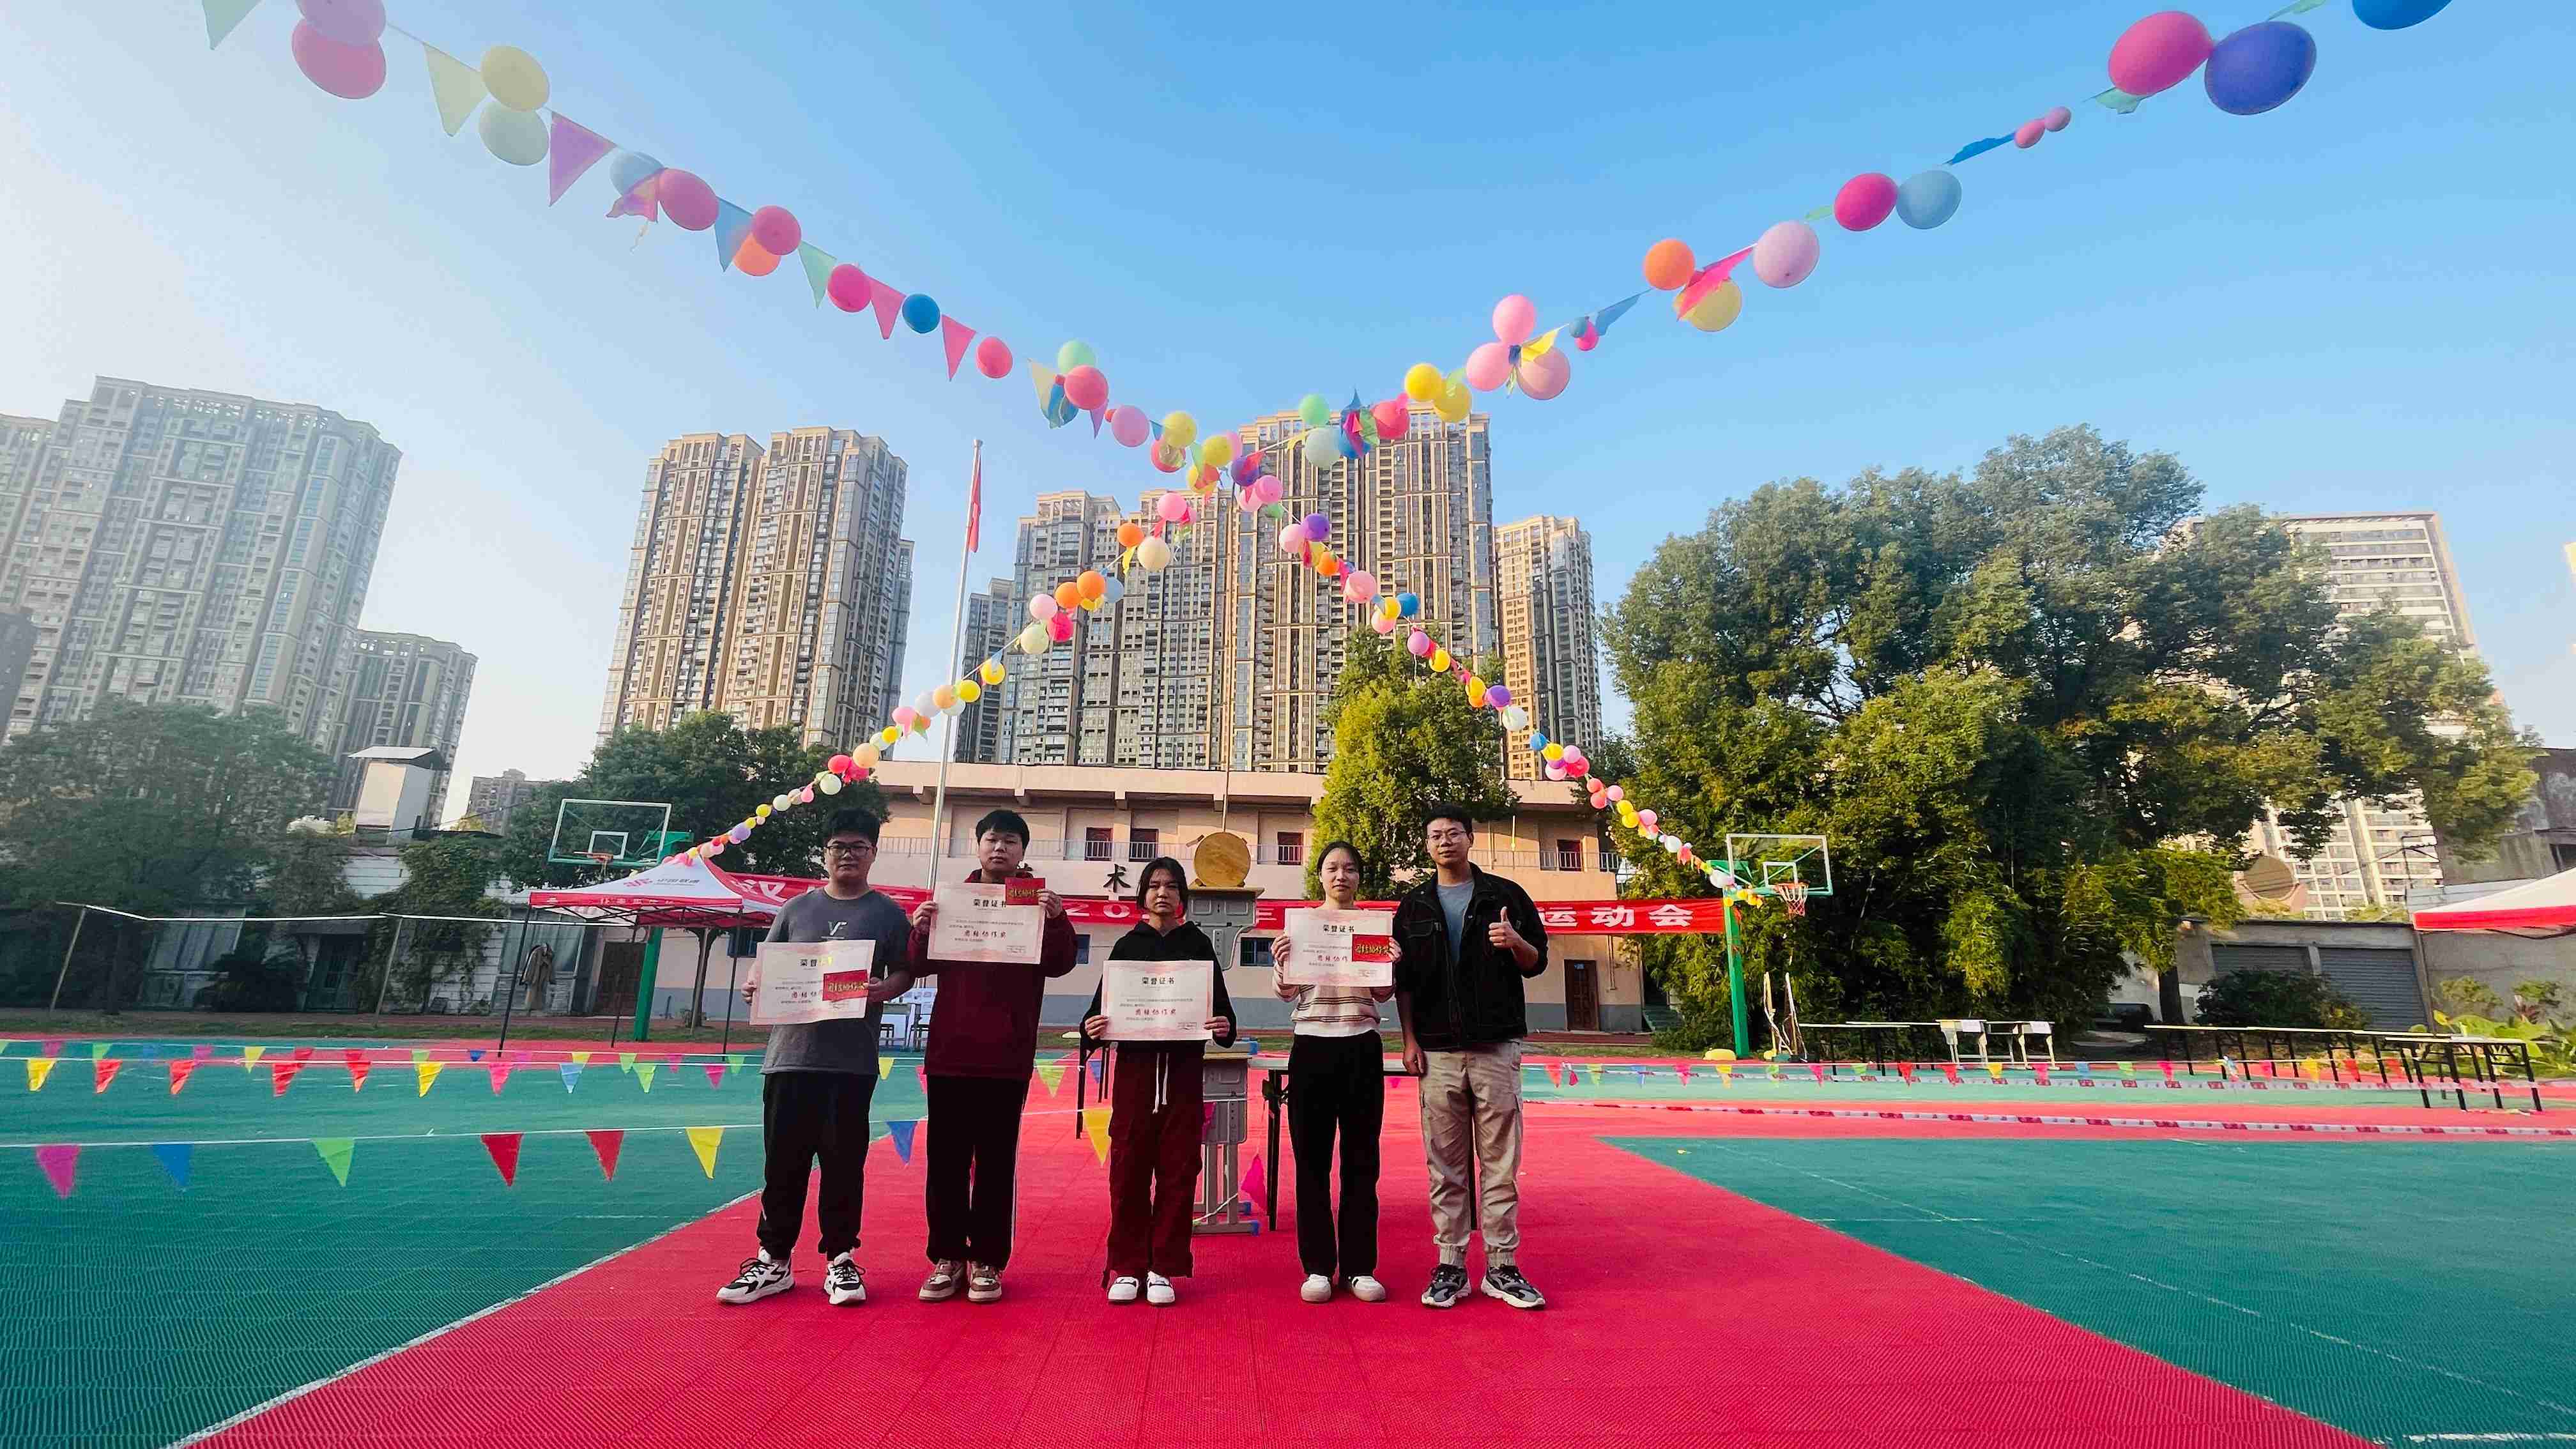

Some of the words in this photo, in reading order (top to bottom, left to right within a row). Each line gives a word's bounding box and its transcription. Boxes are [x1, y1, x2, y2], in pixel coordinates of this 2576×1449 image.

[1102, 863, 1131, 893] 术
[1537, 904, 1693, 927] 运动会
[1323, 924, 1354, 933] 荣誉证书
[1142, 976, 1175, 985] 荣誉证书
